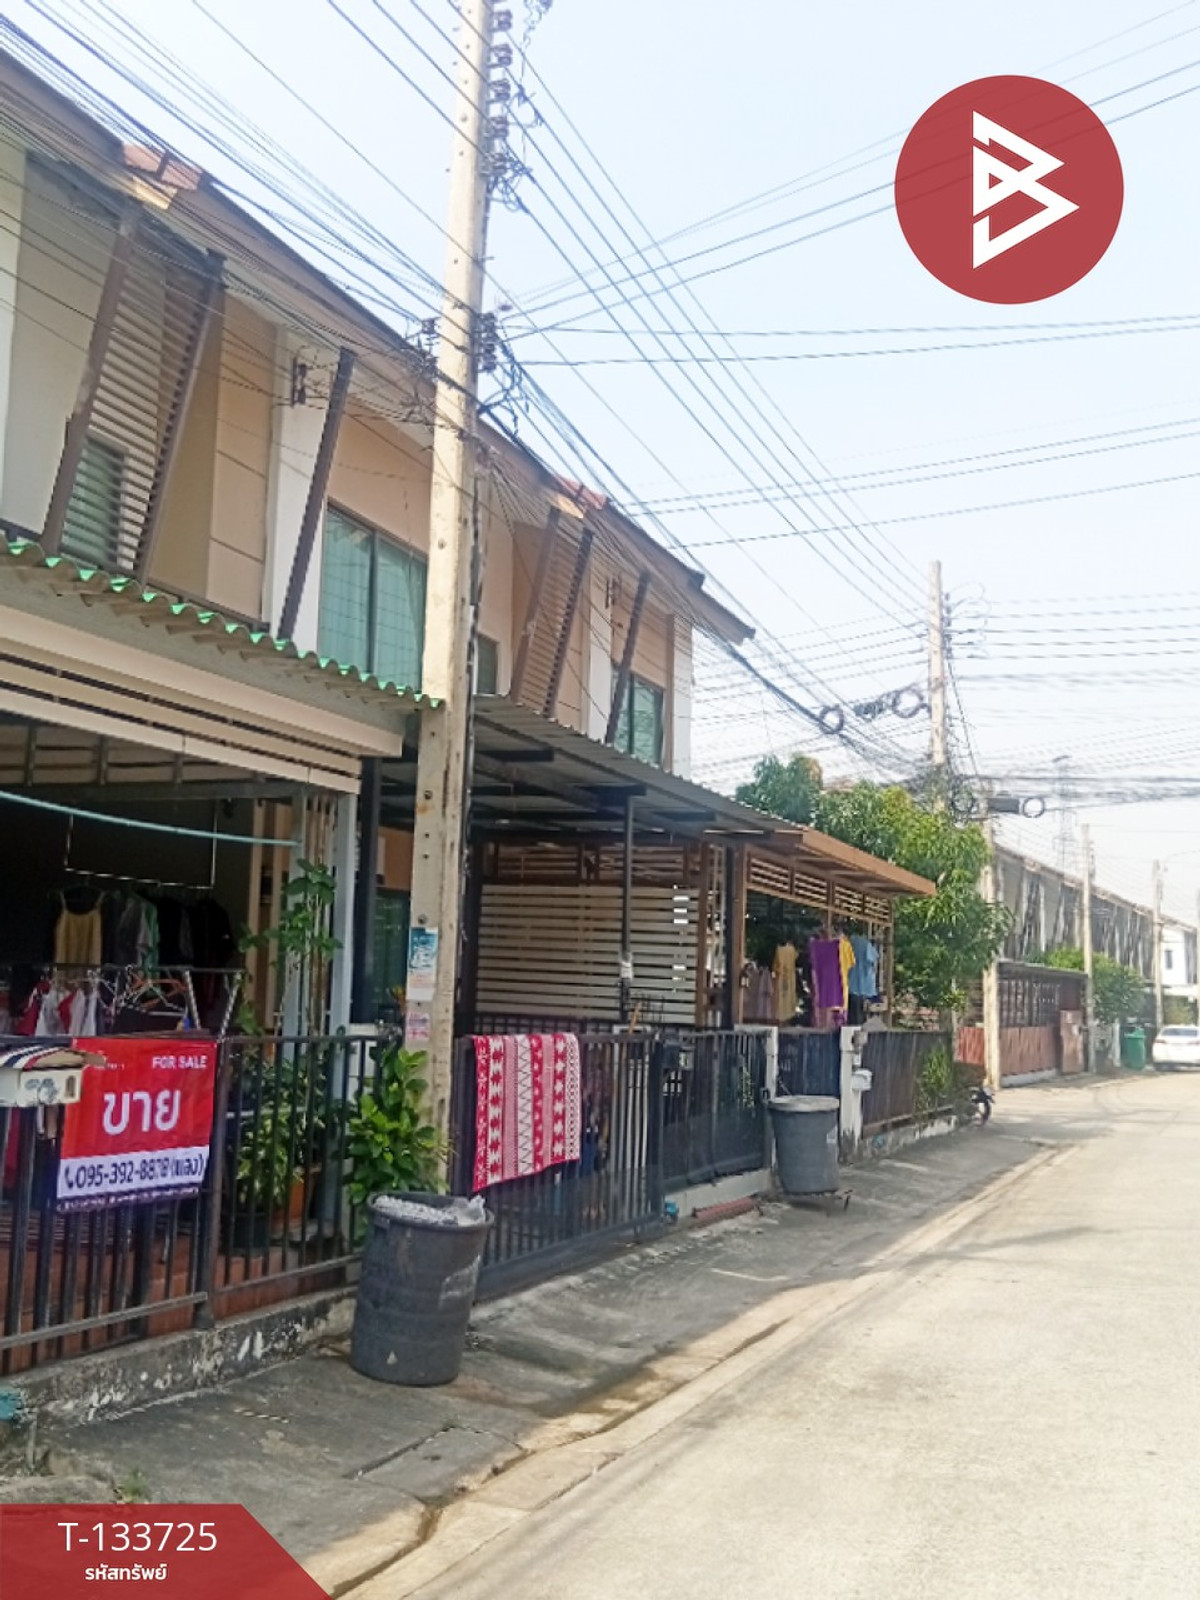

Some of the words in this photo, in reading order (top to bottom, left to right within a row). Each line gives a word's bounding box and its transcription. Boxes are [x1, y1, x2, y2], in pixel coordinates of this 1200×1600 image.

[152, 1056, 176, 1069] FOR
[178, 1055, 207, 1068] SALE
[102, 1089, 181, 1135] ขาย
